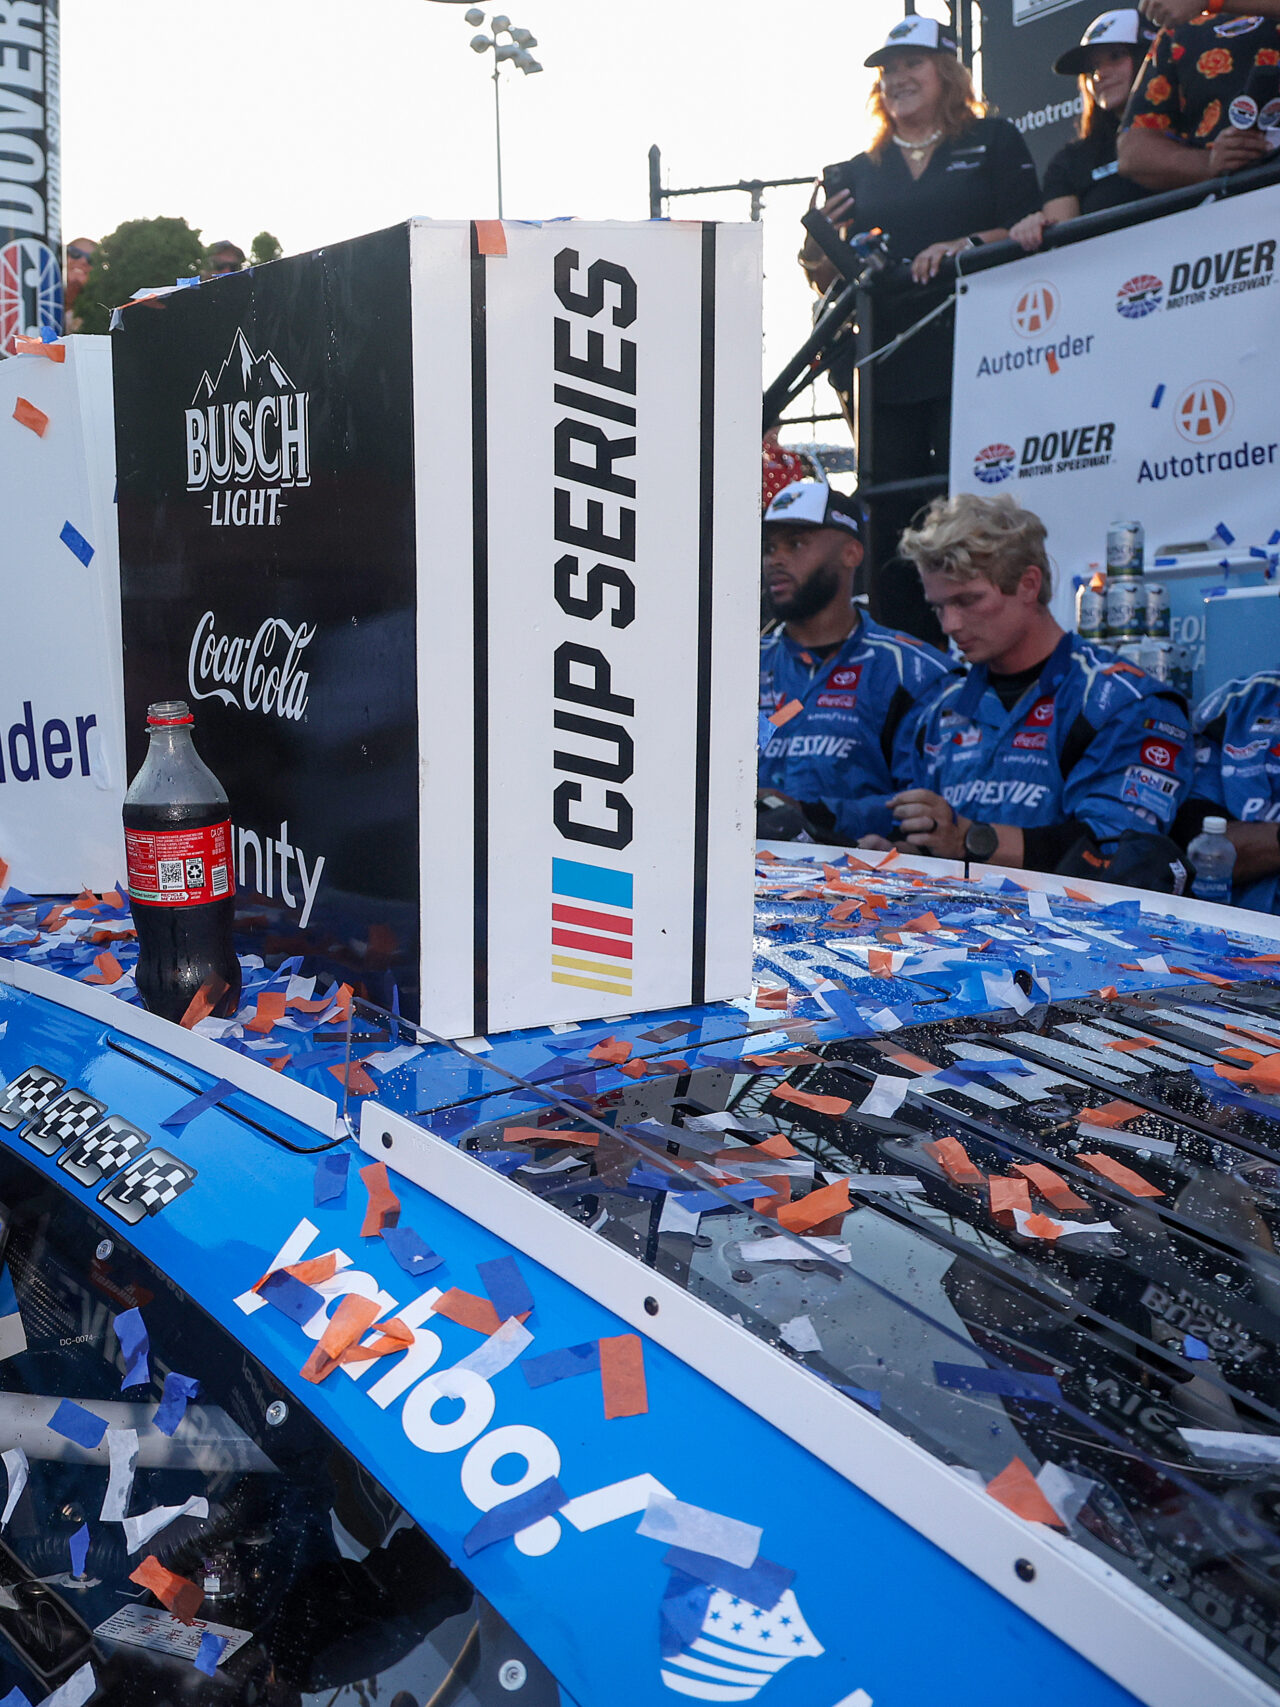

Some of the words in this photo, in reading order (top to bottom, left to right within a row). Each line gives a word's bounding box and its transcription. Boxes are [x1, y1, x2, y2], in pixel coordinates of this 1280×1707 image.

[1007, 93, 1084, 134] utotrad
[1169, 240, 1277, 295] DOVER
[1166, 289, 1206, 311] MOTOR
[1208, 273, 1275, 299] SPEEDWAY
[185, 391, 312, 493] BUSCH
[552, 246, 638, 631] SERIES
[1020, 421, 1116, 466] DOVER
[1056, 454, 1111, 474] SPEEDWAY
[1137, 441, 1279, 484] Autotrader
[210, 488, 277, 527] LIGHT
[188, 609, 318, 722] Coca-Cola
[551, 639, 635, 852] CUP
